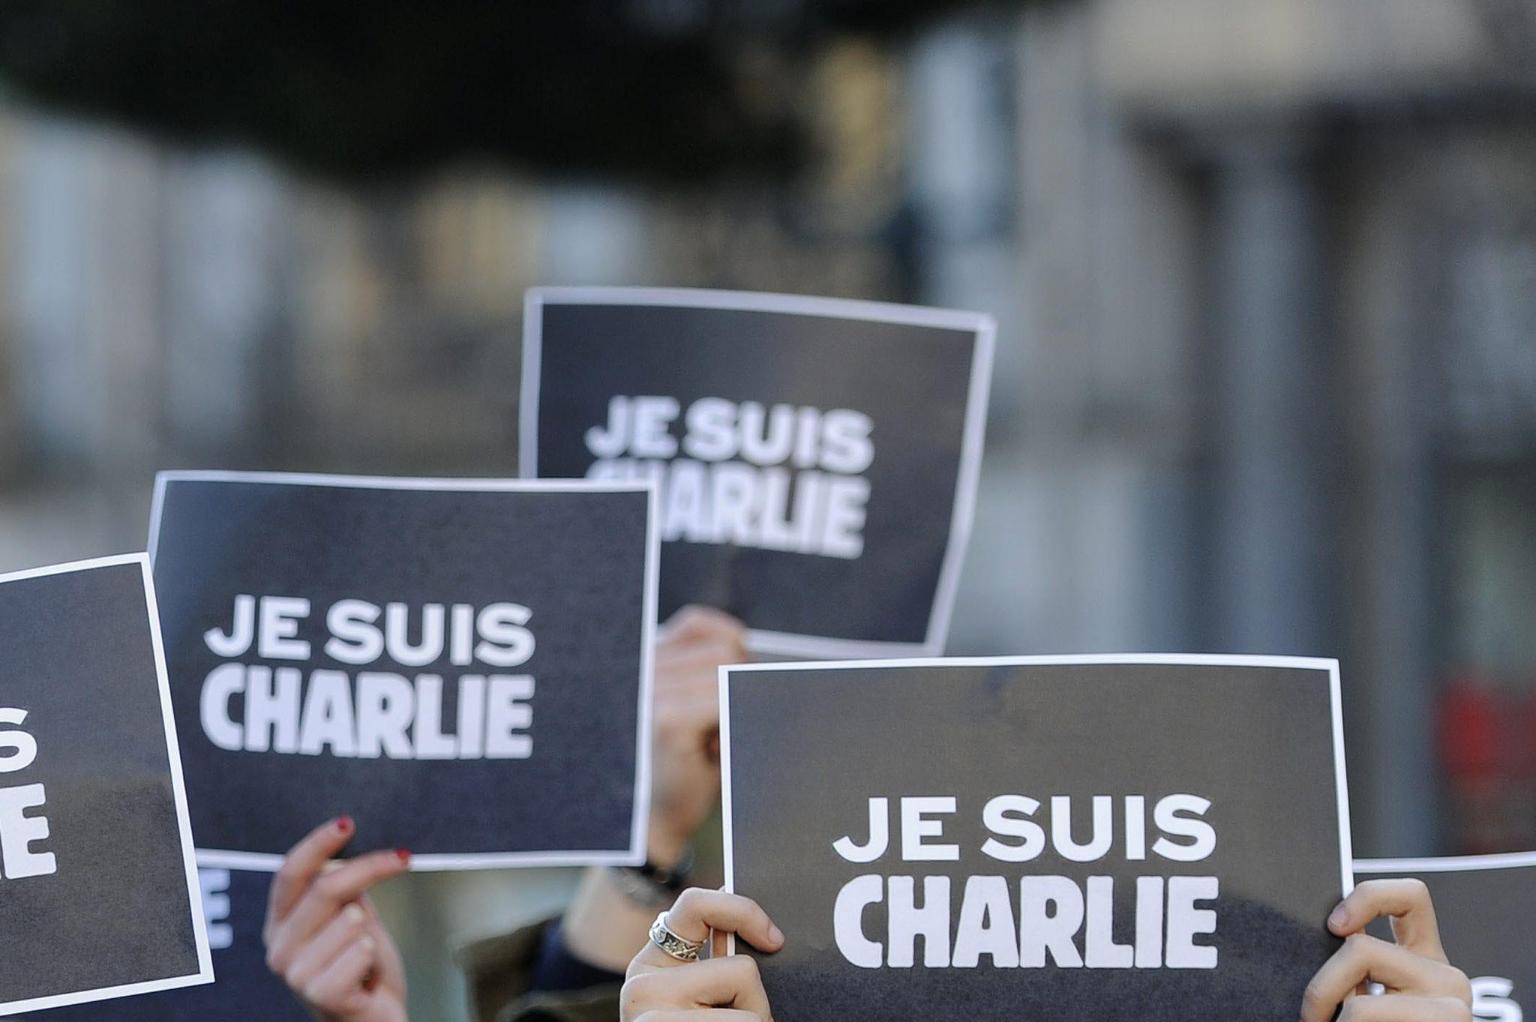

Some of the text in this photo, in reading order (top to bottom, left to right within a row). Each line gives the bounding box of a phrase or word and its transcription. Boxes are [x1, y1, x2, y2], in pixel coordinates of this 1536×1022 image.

[584, 395, 875, 475] JE SUIS
[585, 457, 872, 559] ARLIE
[203, 594, 537, 667] JE SUIS
[200, 662, 536, 760] CHARLIE
[832, 793, 1217, 862] JE SUIS
[833, 874, 1219, 968] CHARLIE
